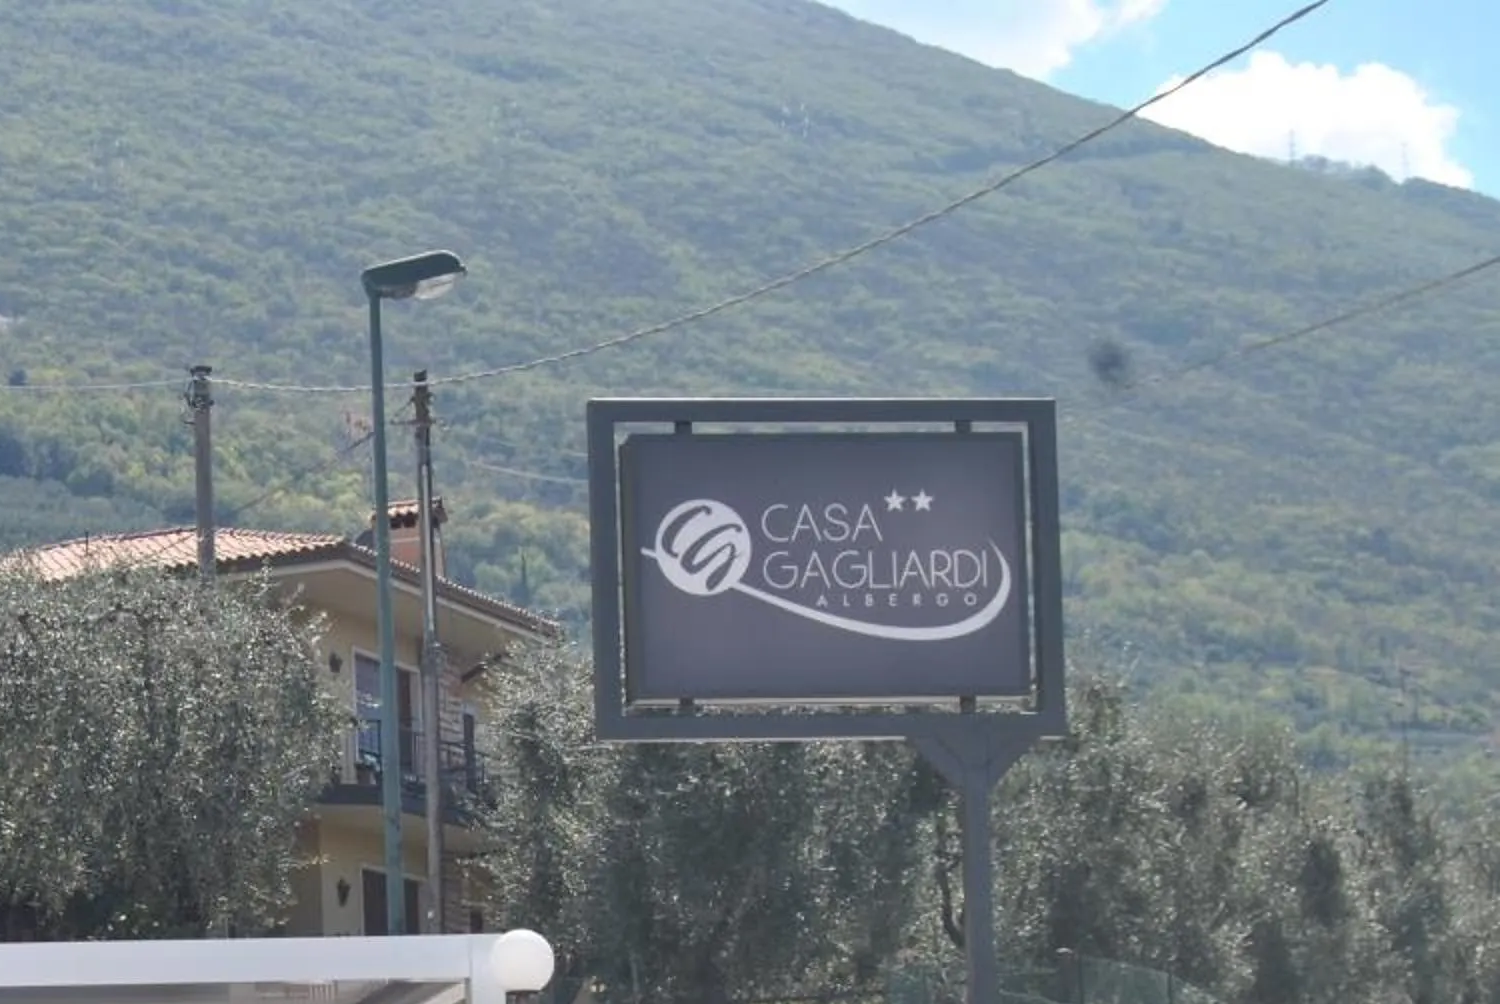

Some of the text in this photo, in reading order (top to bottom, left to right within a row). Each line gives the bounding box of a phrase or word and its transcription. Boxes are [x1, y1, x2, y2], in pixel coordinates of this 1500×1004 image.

[760, 502, 884, 543] CASA
[762, 549, 988, 590] GAGLIARDI
[816, 593, 979, 608] ALBERGO
